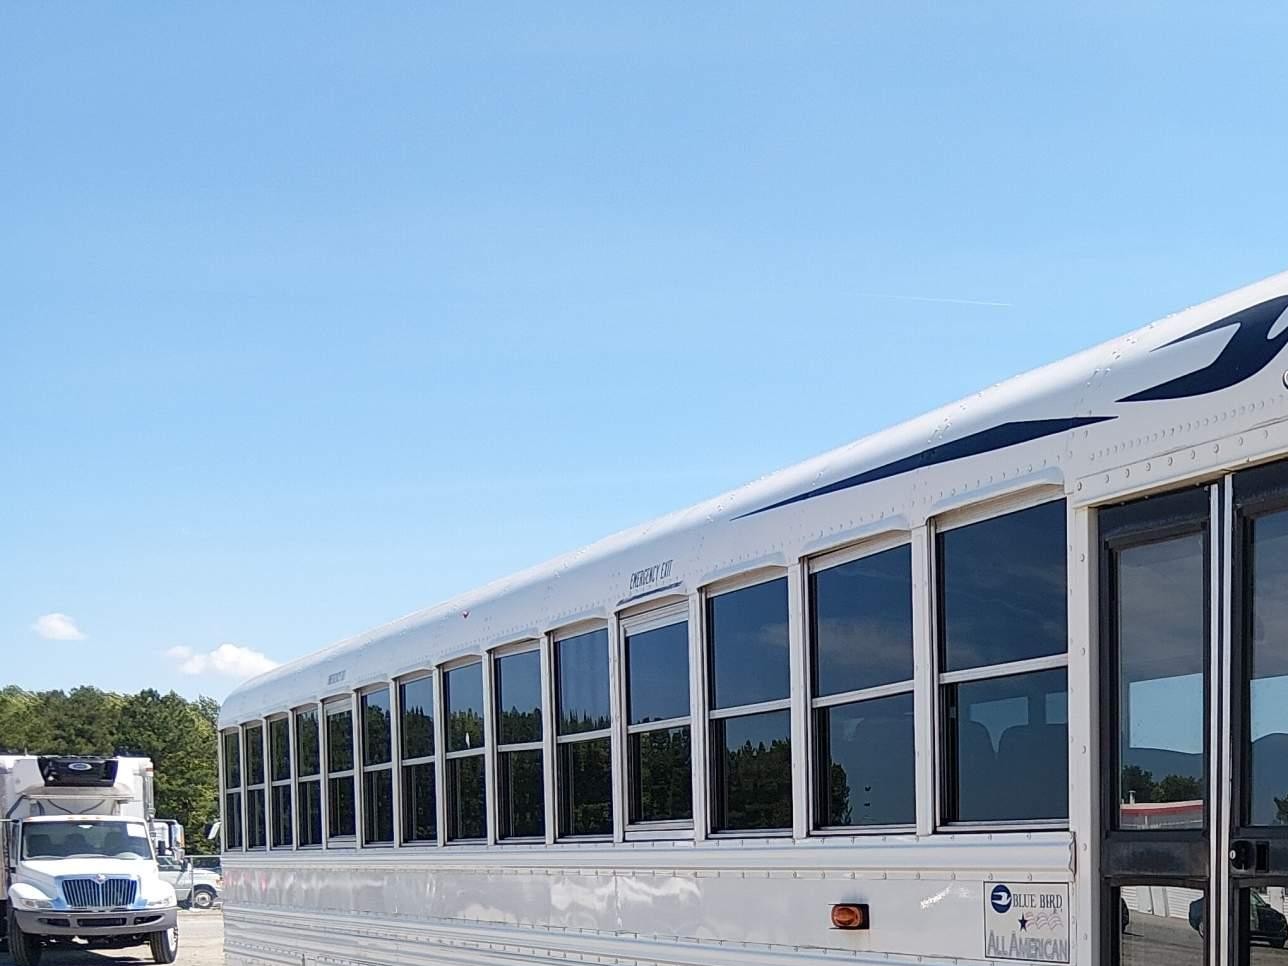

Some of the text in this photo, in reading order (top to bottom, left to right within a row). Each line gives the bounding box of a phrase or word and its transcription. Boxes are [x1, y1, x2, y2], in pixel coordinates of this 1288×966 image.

[1013, 893, 1063, 910] BLUE BIRD
[988, 930, 1067, 960] ALL AMERICAN
